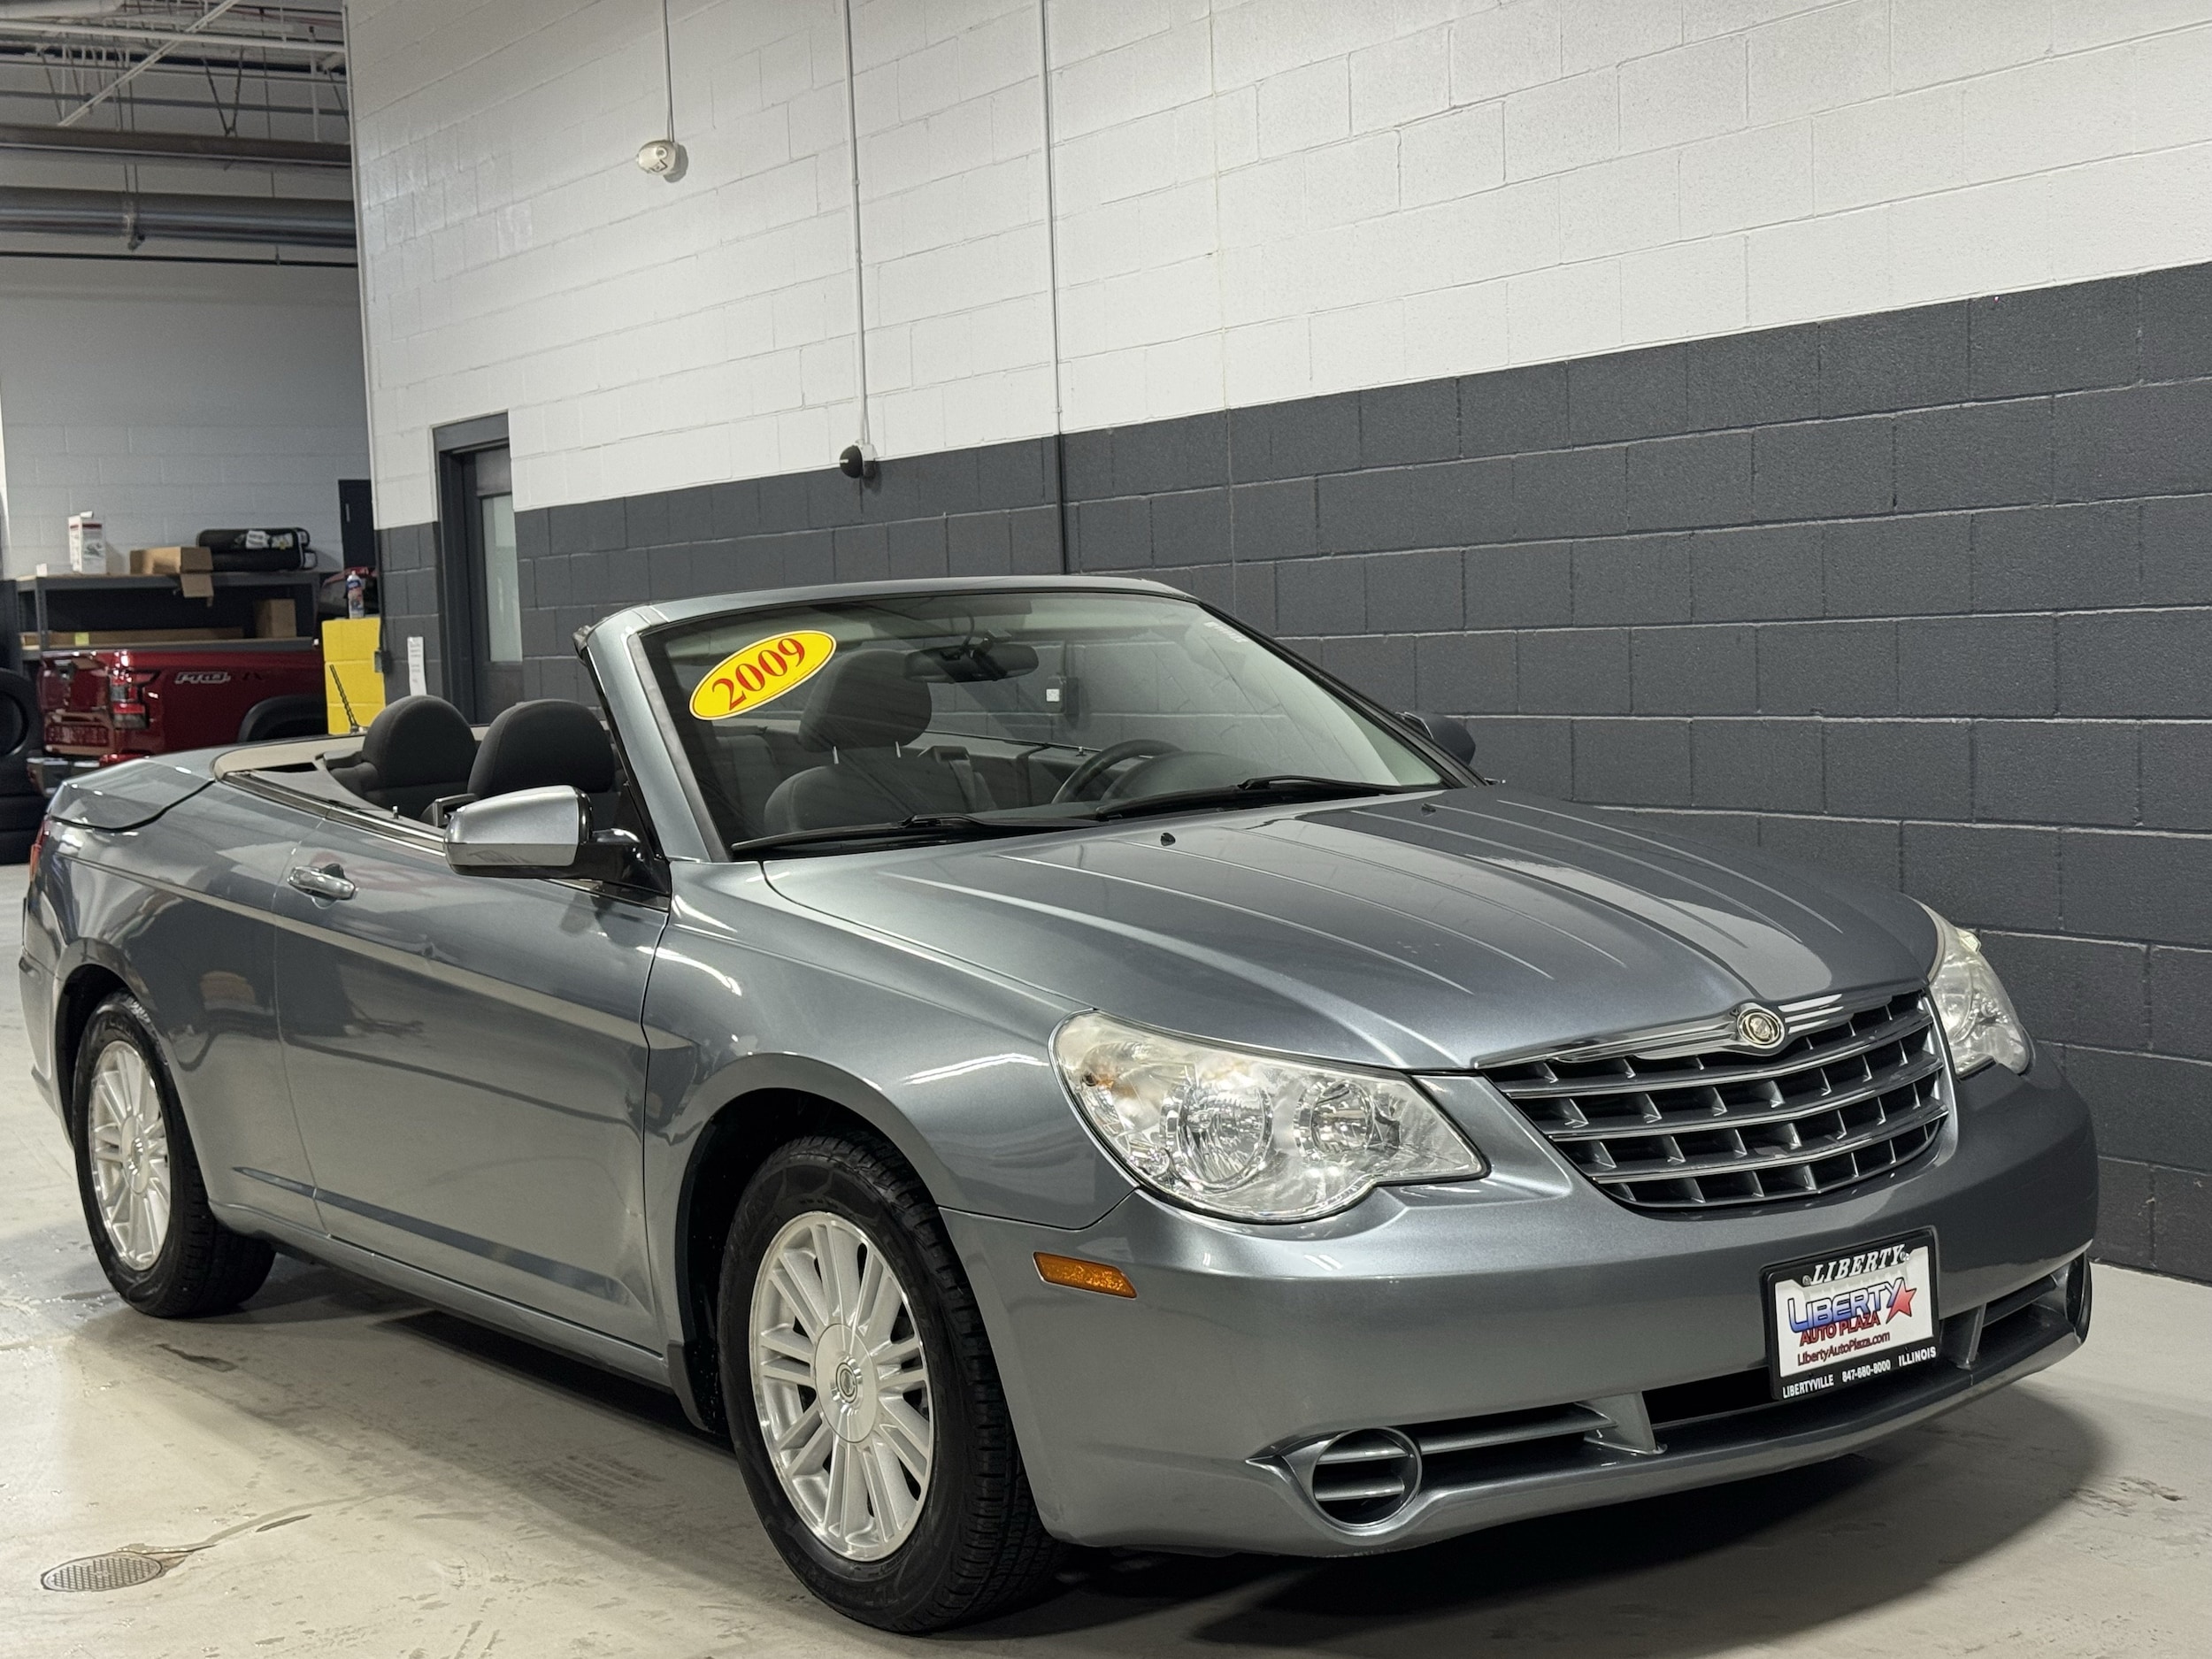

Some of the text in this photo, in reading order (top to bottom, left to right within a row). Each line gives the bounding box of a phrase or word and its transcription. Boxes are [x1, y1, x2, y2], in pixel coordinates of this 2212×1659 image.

[711, 638, 805, 710] 2009
[1810, 1244, 1905, 1286] LIBERTY
[1797, 1333, 1890, 1366] LibertyAutoPlaza.com
[1800, 1310, 1881, 1347] AUTO PLAZA
[1783, 1374, 1834, 1398] LIBERTYVILLE
[1898, 1346, 1937, 1367] ILLINOIS
